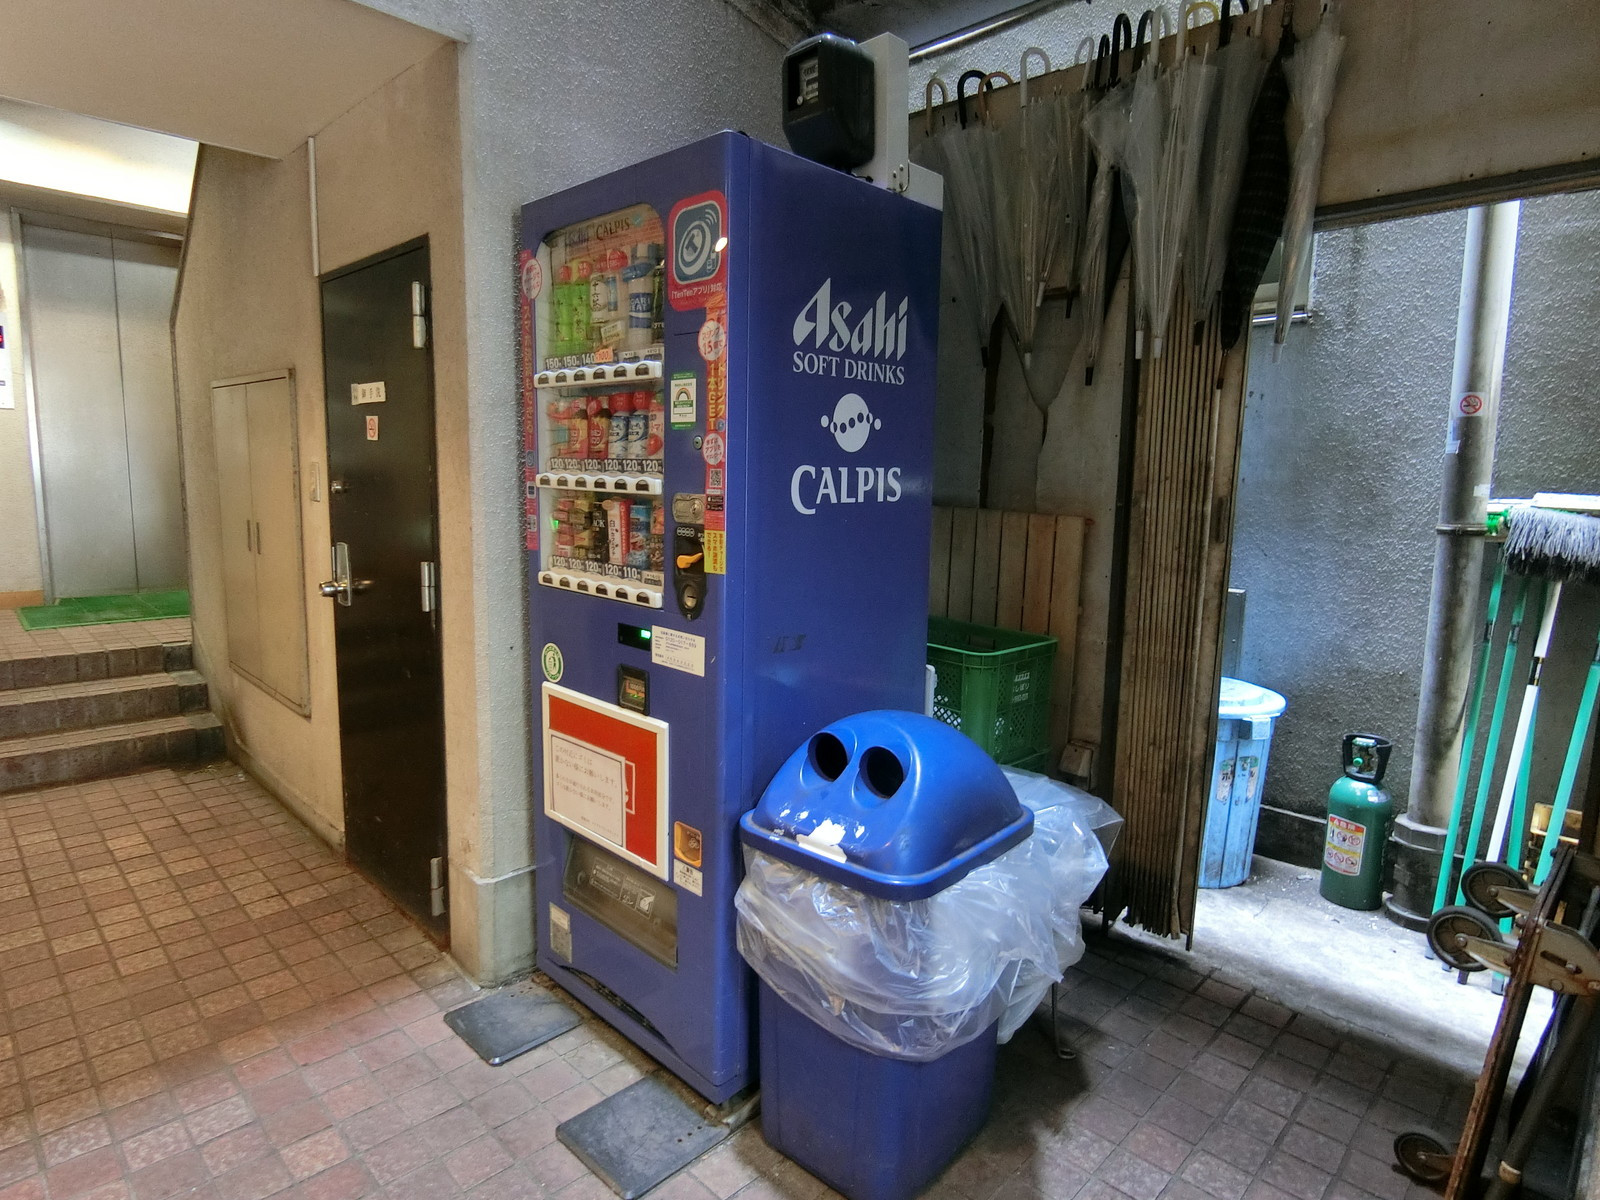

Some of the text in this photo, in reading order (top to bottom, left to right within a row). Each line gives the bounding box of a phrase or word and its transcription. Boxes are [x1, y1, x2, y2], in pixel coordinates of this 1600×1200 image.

[596, 217, 630, 241] CALPIS
[792, 277, 909, 361] Asahi
[793, 351, 905, 385] SOFT DRINKS
[790, 464, 902, 515] CALPIS
